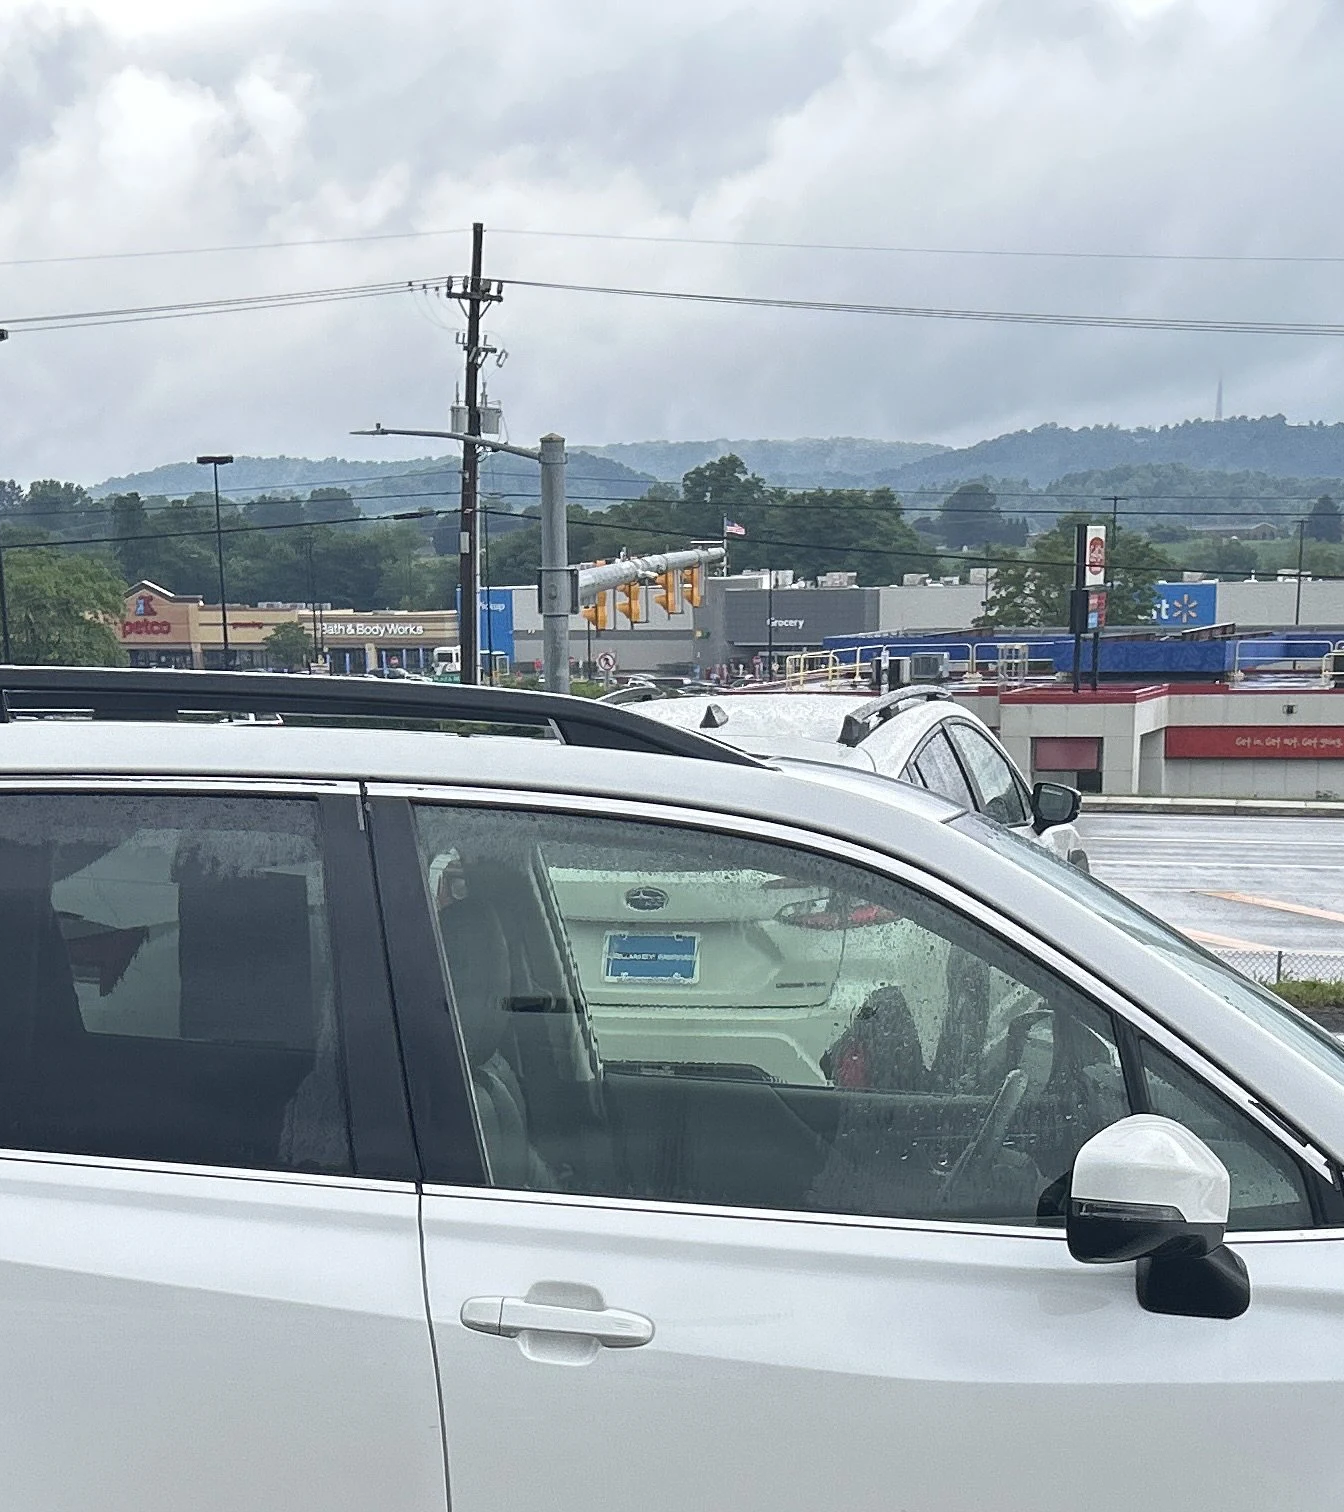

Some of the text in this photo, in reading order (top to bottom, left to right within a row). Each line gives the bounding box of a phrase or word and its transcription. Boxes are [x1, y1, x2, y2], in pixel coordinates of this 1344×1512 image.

[122, 618, 171, 638] petco
[322, 623, 424, 637] Bath & Body Works
[766, 617, 805, 630] Grocery
